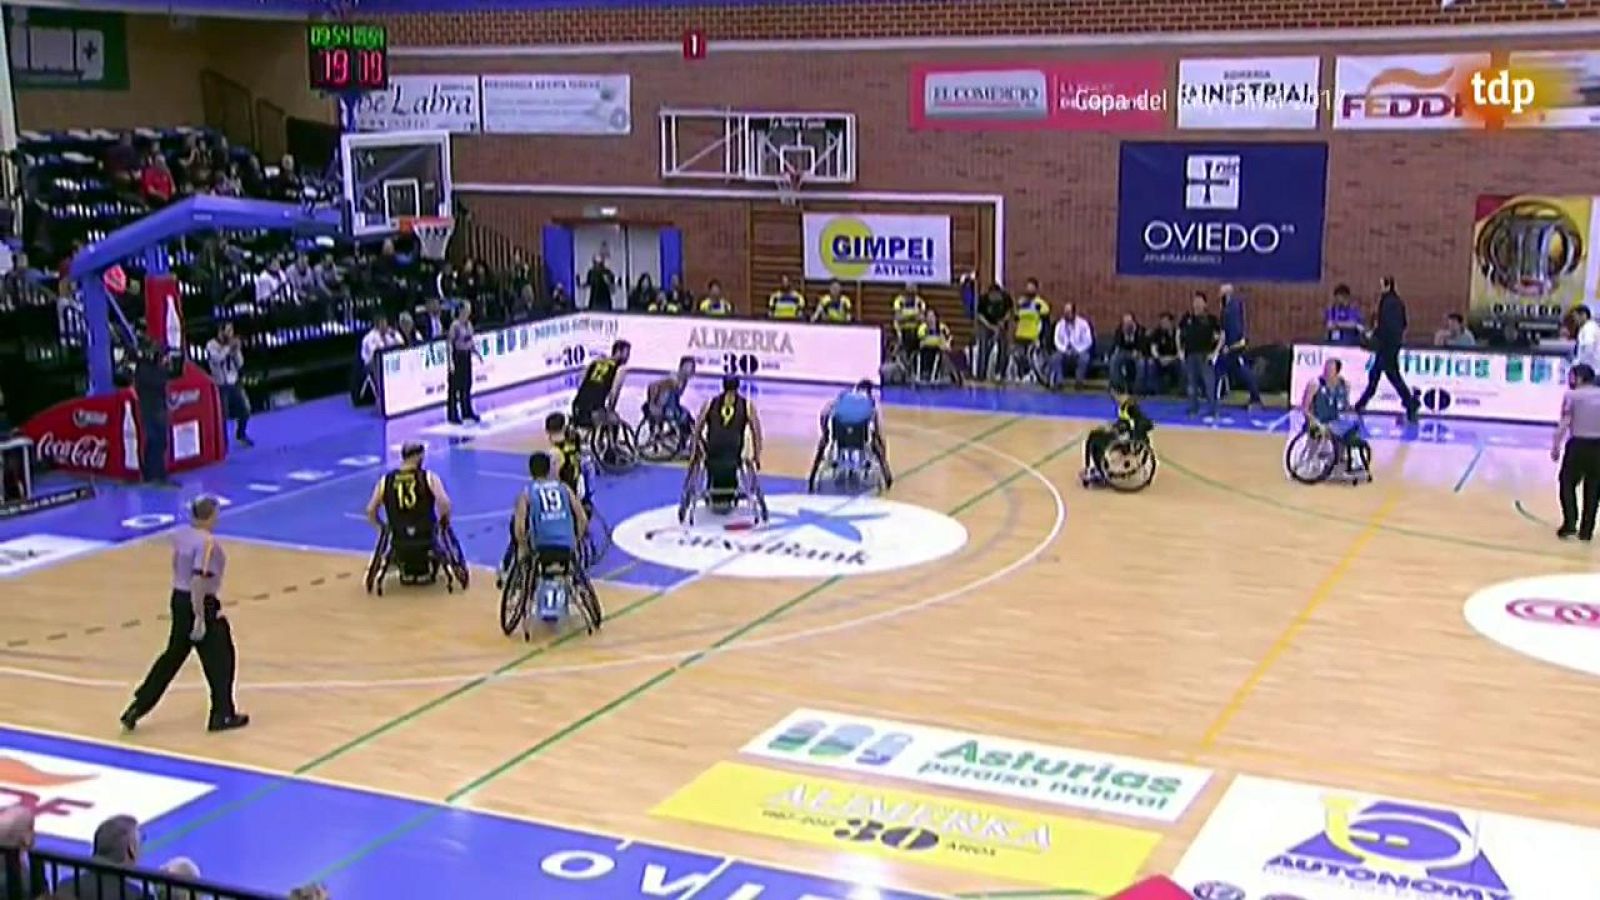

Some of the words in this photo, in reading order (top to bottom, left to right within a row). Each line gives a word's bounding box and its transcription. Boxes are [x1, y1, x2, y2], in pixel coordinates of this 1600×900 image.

[691, 35, 697, 55] 1
[832, 235, 934, 260] GIMPEI
[1144, 219, 1280, 254] OVIEDO
[874, 264, 934, 276] ASTURIAS
[687, 326, 794, 354] ALIMERKA
[723, 352, 759, 375] 30
[720, 403, 734, 427] 9
[395, 481, 417, 509] 13
[539, 488, 562, 511] 19
[935, 739, 1182, 794] Asturias
[1050, 782, 1169, 810] natural
[760, 782, 1051, 854] ALIMERKA
[833, 818, 940, 851] 30
